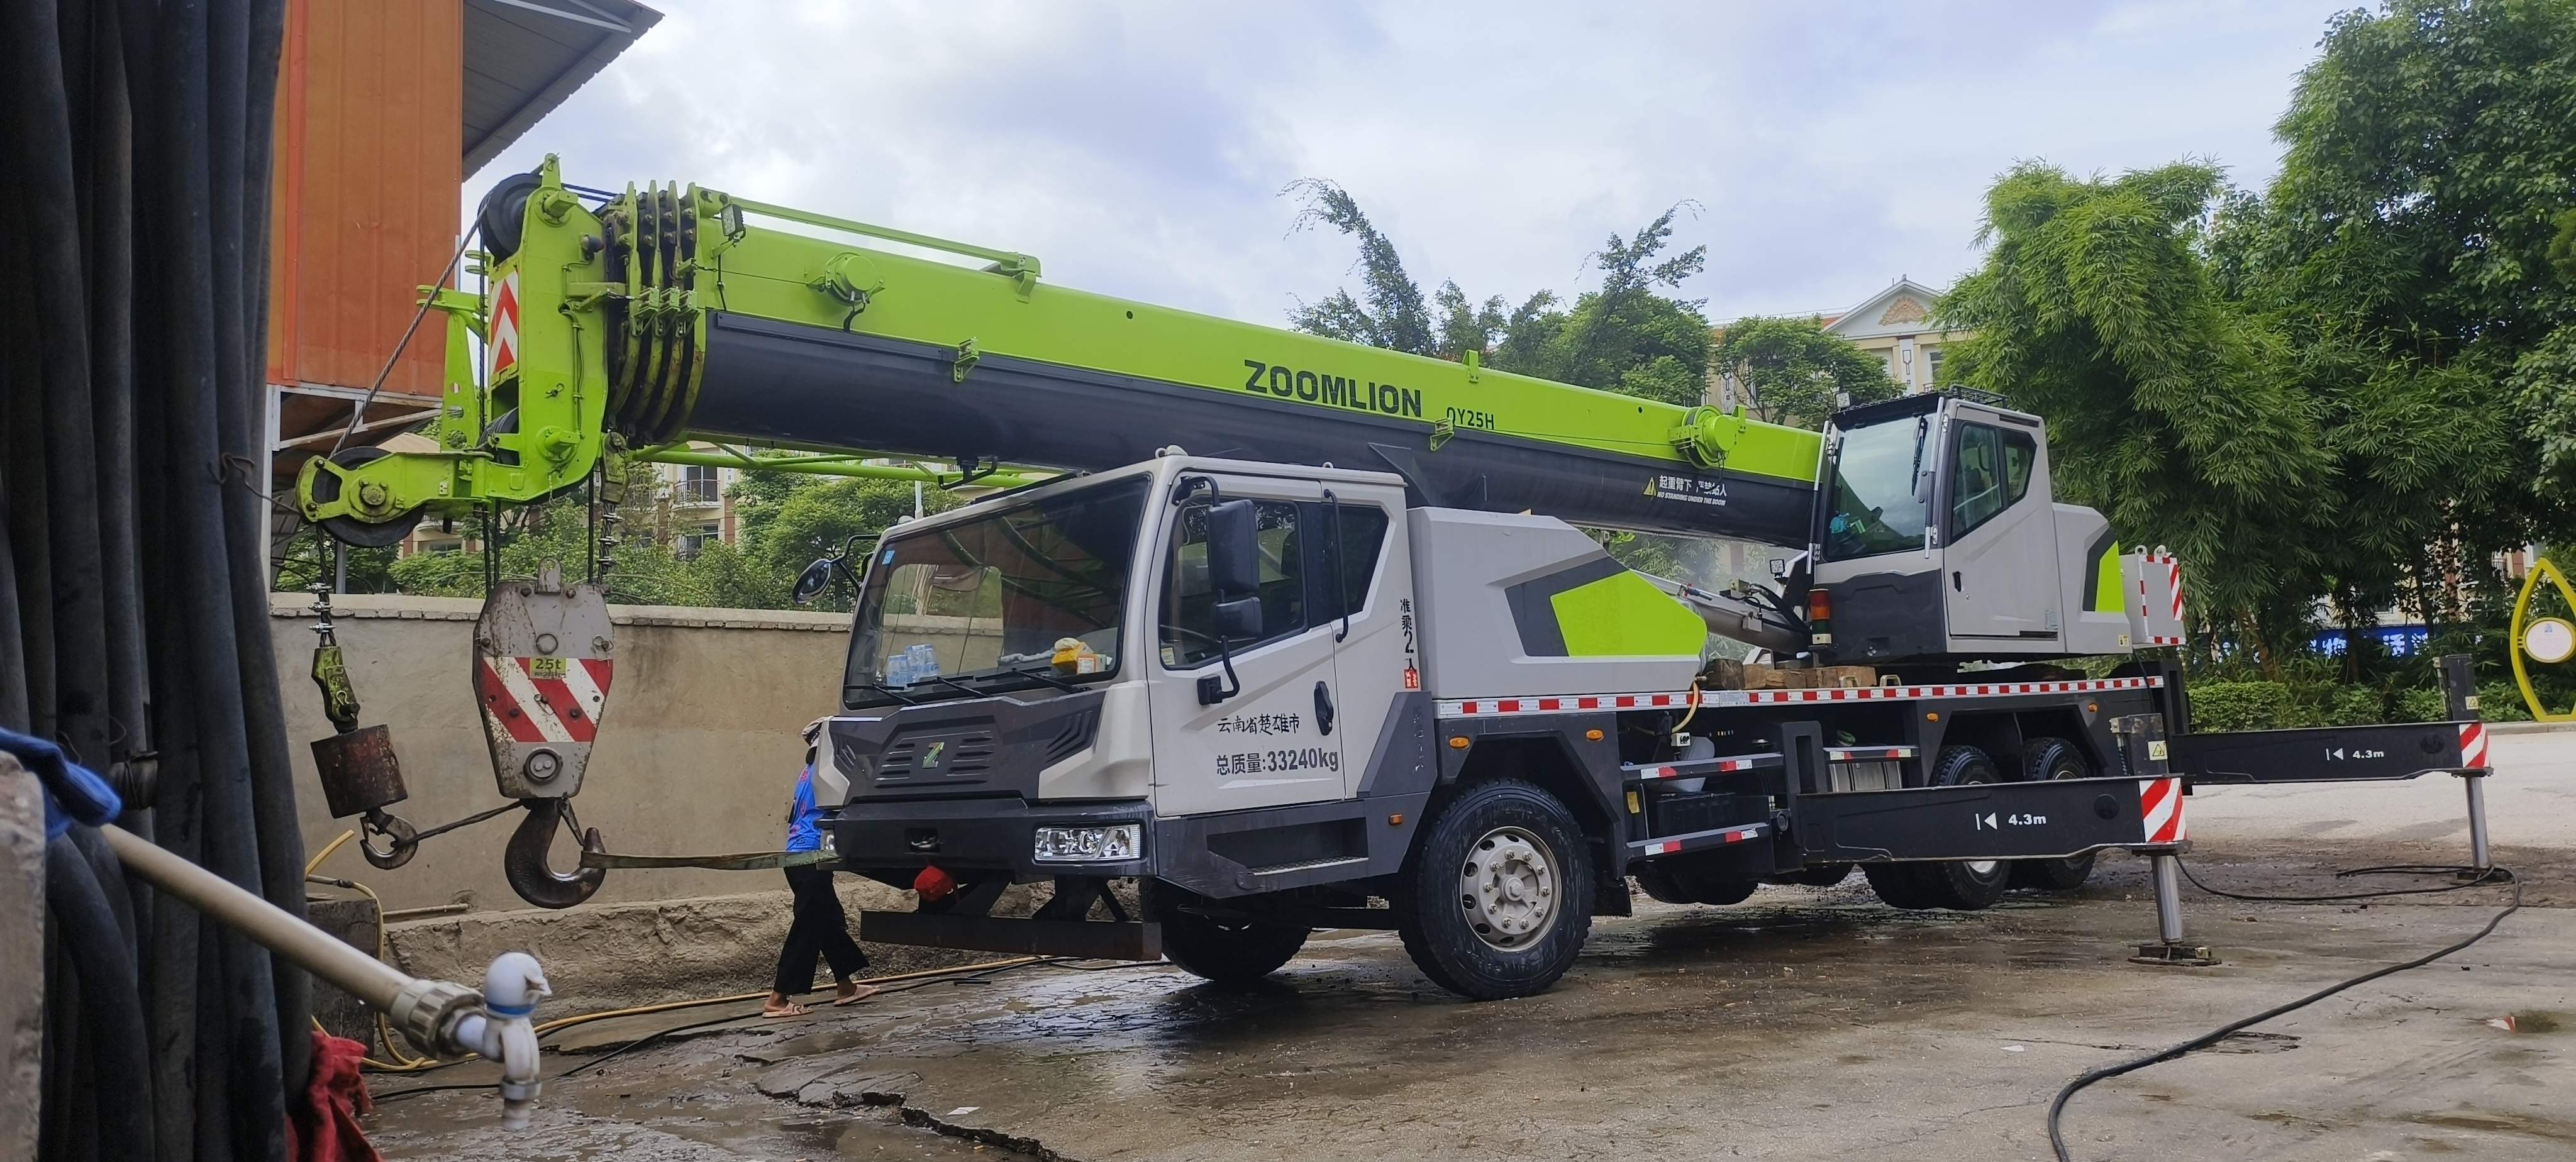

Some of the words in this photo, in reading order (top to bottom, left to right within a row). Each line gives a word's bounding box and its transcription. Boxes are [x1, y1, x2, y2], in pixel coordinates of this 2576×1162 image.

[1244, 359, 1422, 418] ZOOMLION
[1659, 475, 1692, 492] 起重臂下
[1665, 492, 1688, 501] STANDING
[1400, 598, 1417, 672] 准乘2人
[535, 658, 562, 670] 25t
[1217, 713, 1300, 736] 云南省楚雄市
[1216, 748, 1339, 776] 总质量:33240kg
[2352, 750, 2384, 759] 4.3m
[2008, 814, 2046, 826] 4.3m
